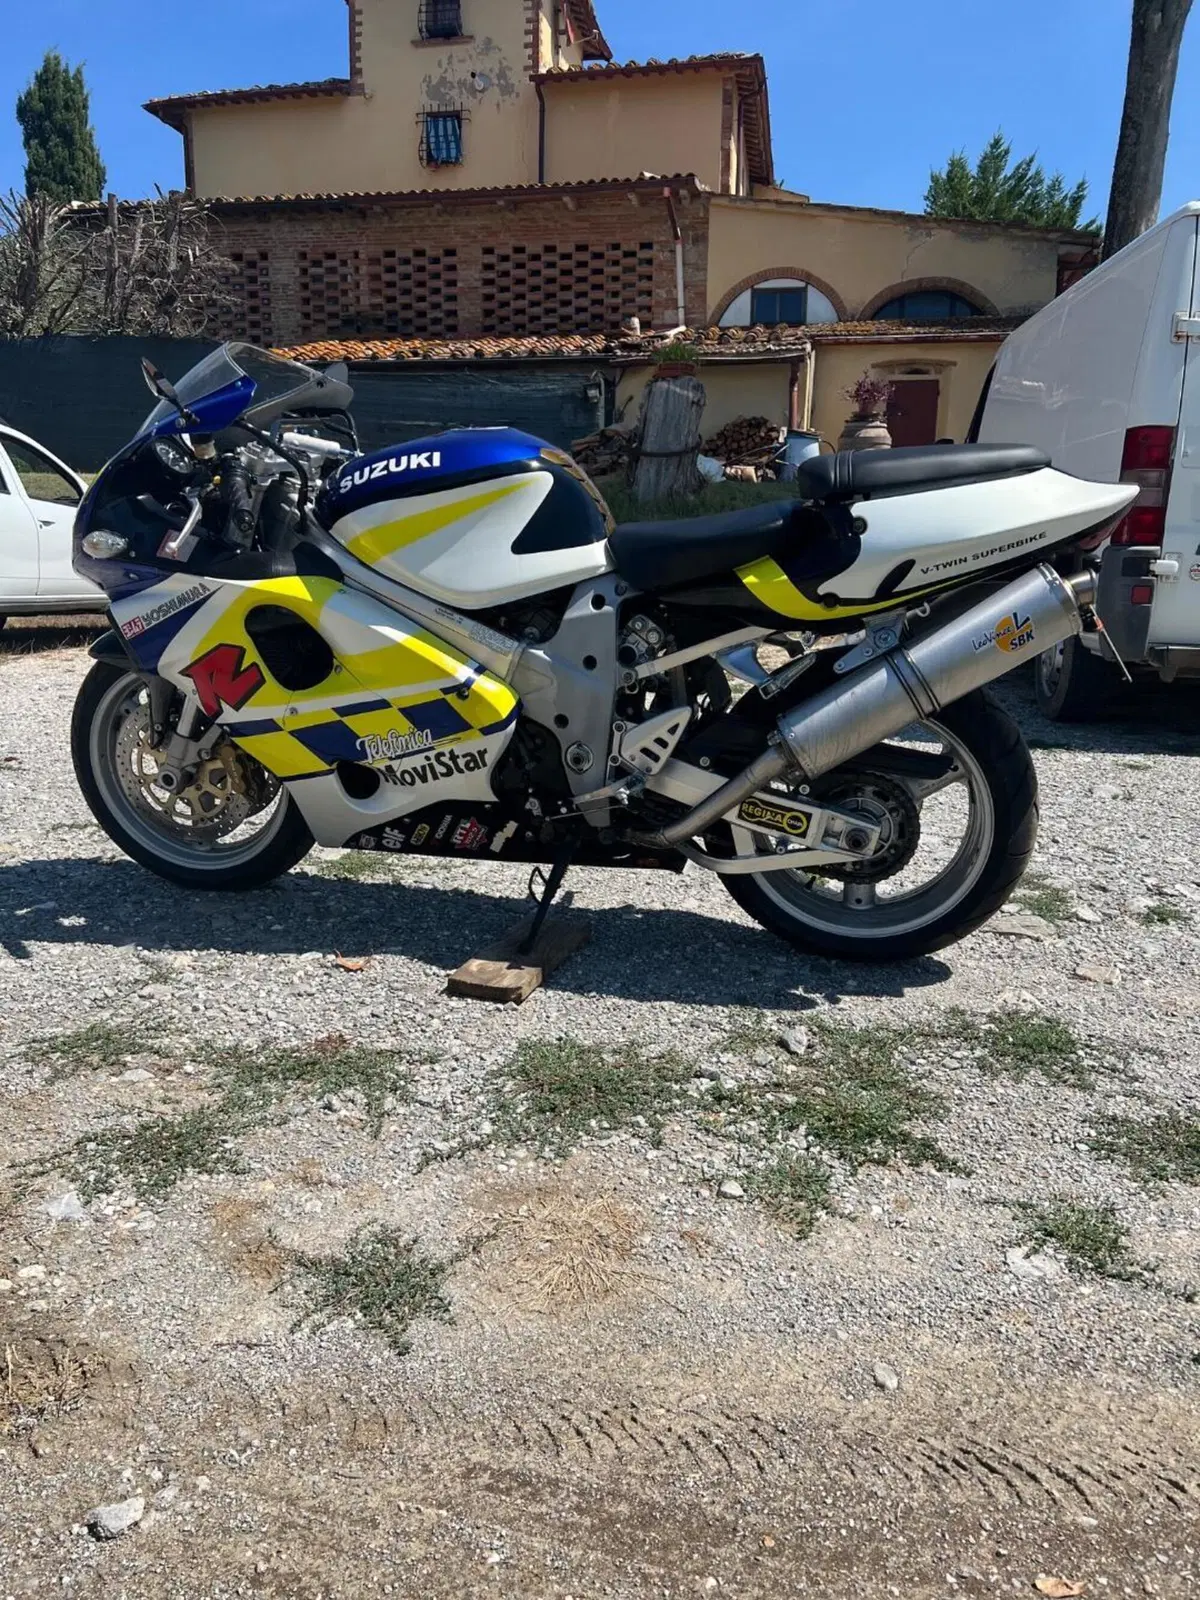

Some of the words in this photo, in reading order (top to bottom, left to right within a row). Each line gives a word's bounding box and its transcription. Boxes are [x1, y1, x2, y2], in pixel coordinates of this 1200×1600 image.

[340, 451, 441, 494] SUZUKI
[920, 556, 968, 575] V-TWIN
[971, 531, 1048, 561] SUPERBIKE
[141, 582, 211, 627] YOSHIMURA
[1009, 629, 1035, 650] SBK
[380, 747, 489, 787] MoviStar
[741, 802, 783, 823] REGINA
